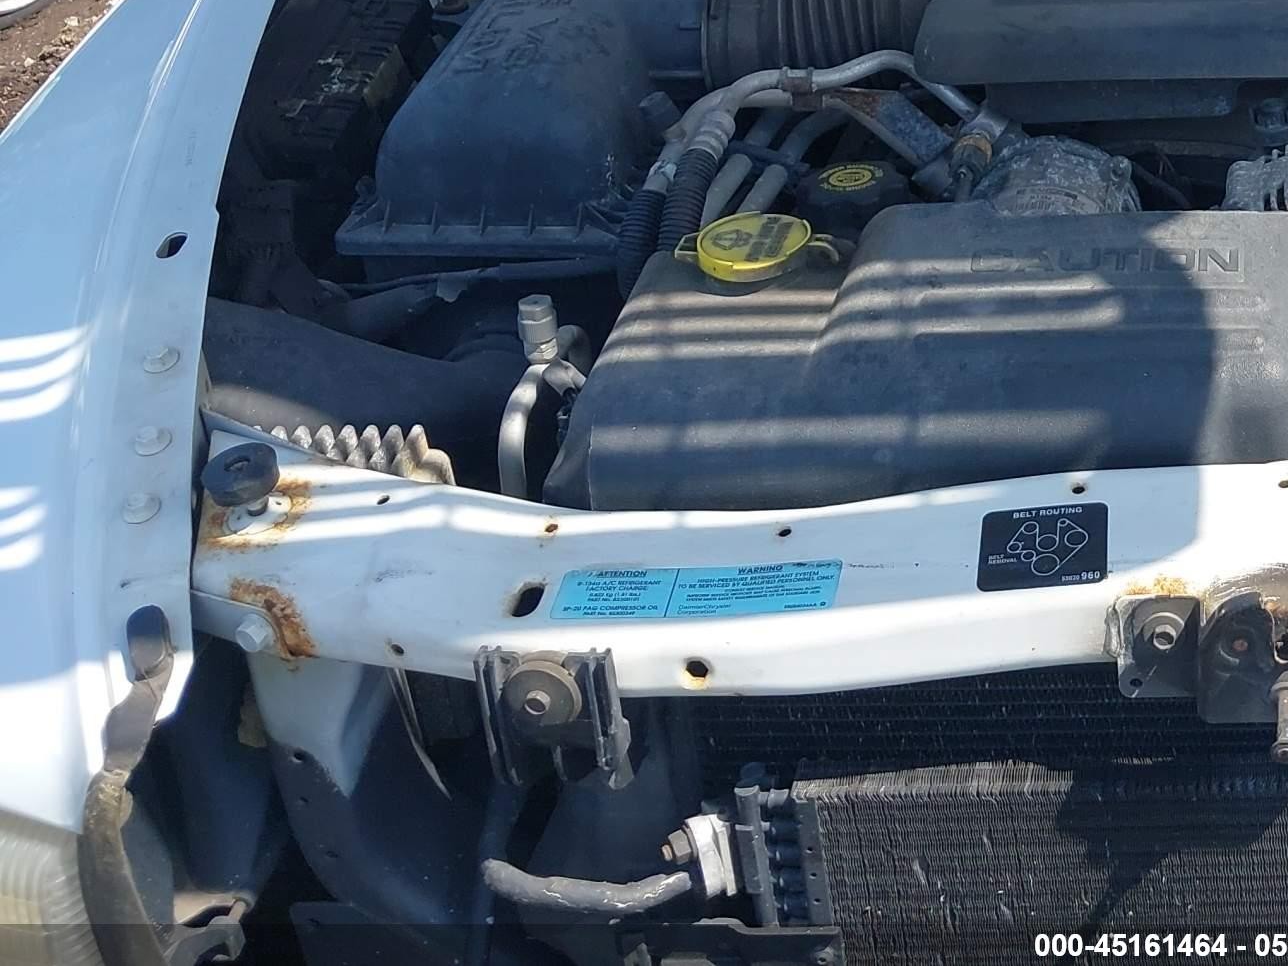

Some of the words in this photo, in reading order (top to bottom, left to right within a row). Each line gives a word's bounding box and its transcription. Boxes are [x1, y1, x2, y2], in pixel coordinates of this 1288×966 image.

[970, 247, 1239, 273] CAUTION
[1013, 511, 1037, 519] BELT
[1040, 506, 1083, 517] ROUTING
[596, 570, 648, 578] ATTENTION
[738, 565, 783, 575] WARNING
[1081, 571, 1100, 580] 960
